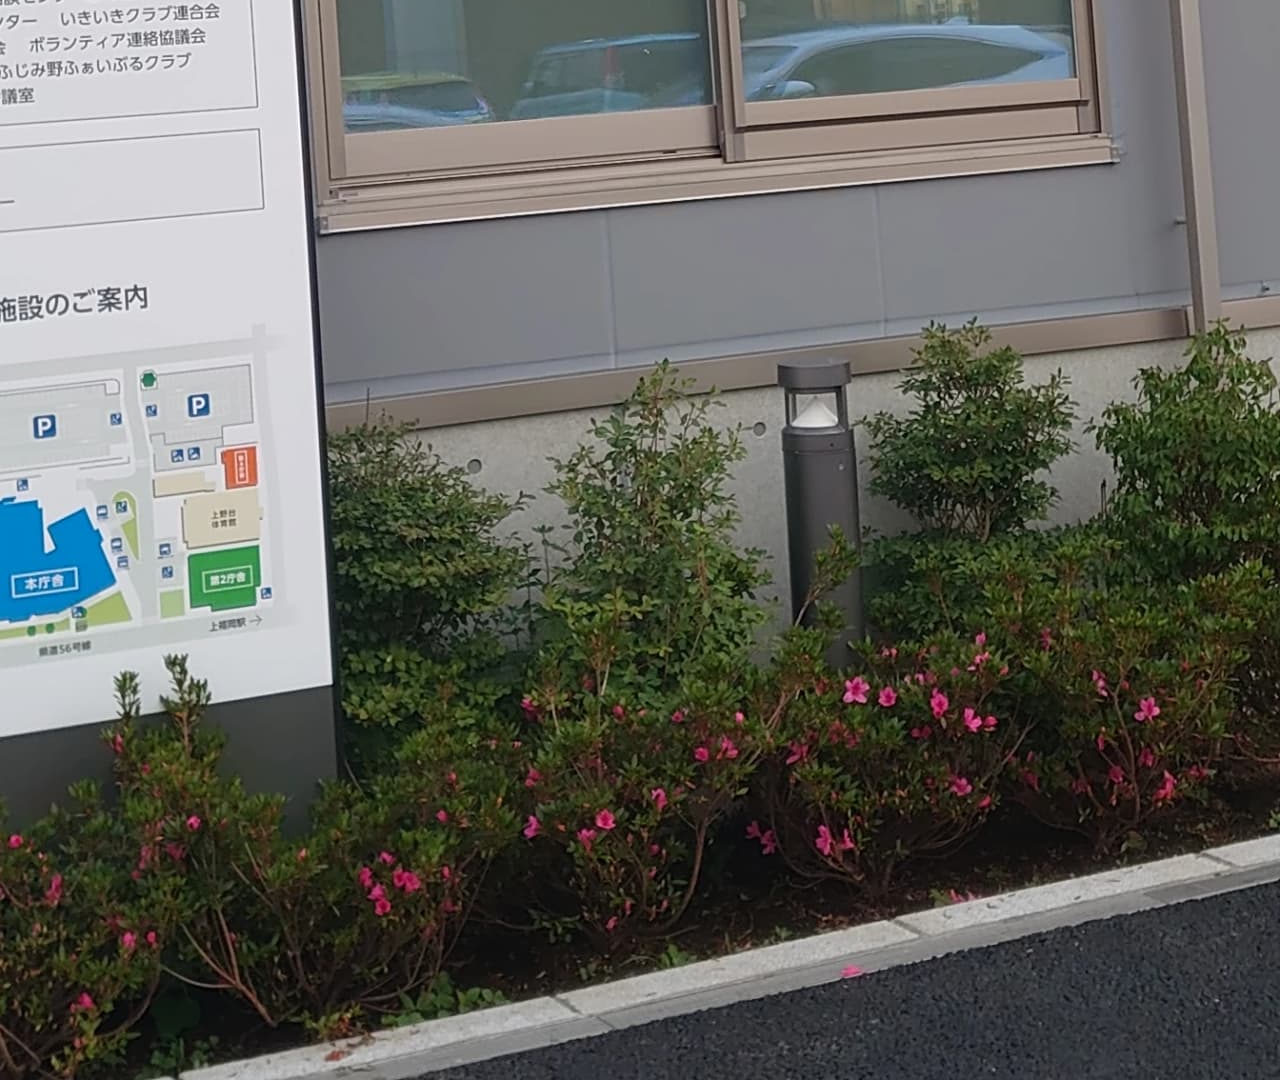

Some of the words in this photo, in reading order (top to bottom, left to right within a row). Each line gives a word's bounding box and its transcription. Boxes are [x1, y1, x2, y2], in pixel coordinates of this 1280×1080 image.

[60, 3, 221, 27] いきいきクラブ連合会
[29, 27, 207, 54] ボランティア連絡協議会
[23, 573, 65, 591] 本庁舎
